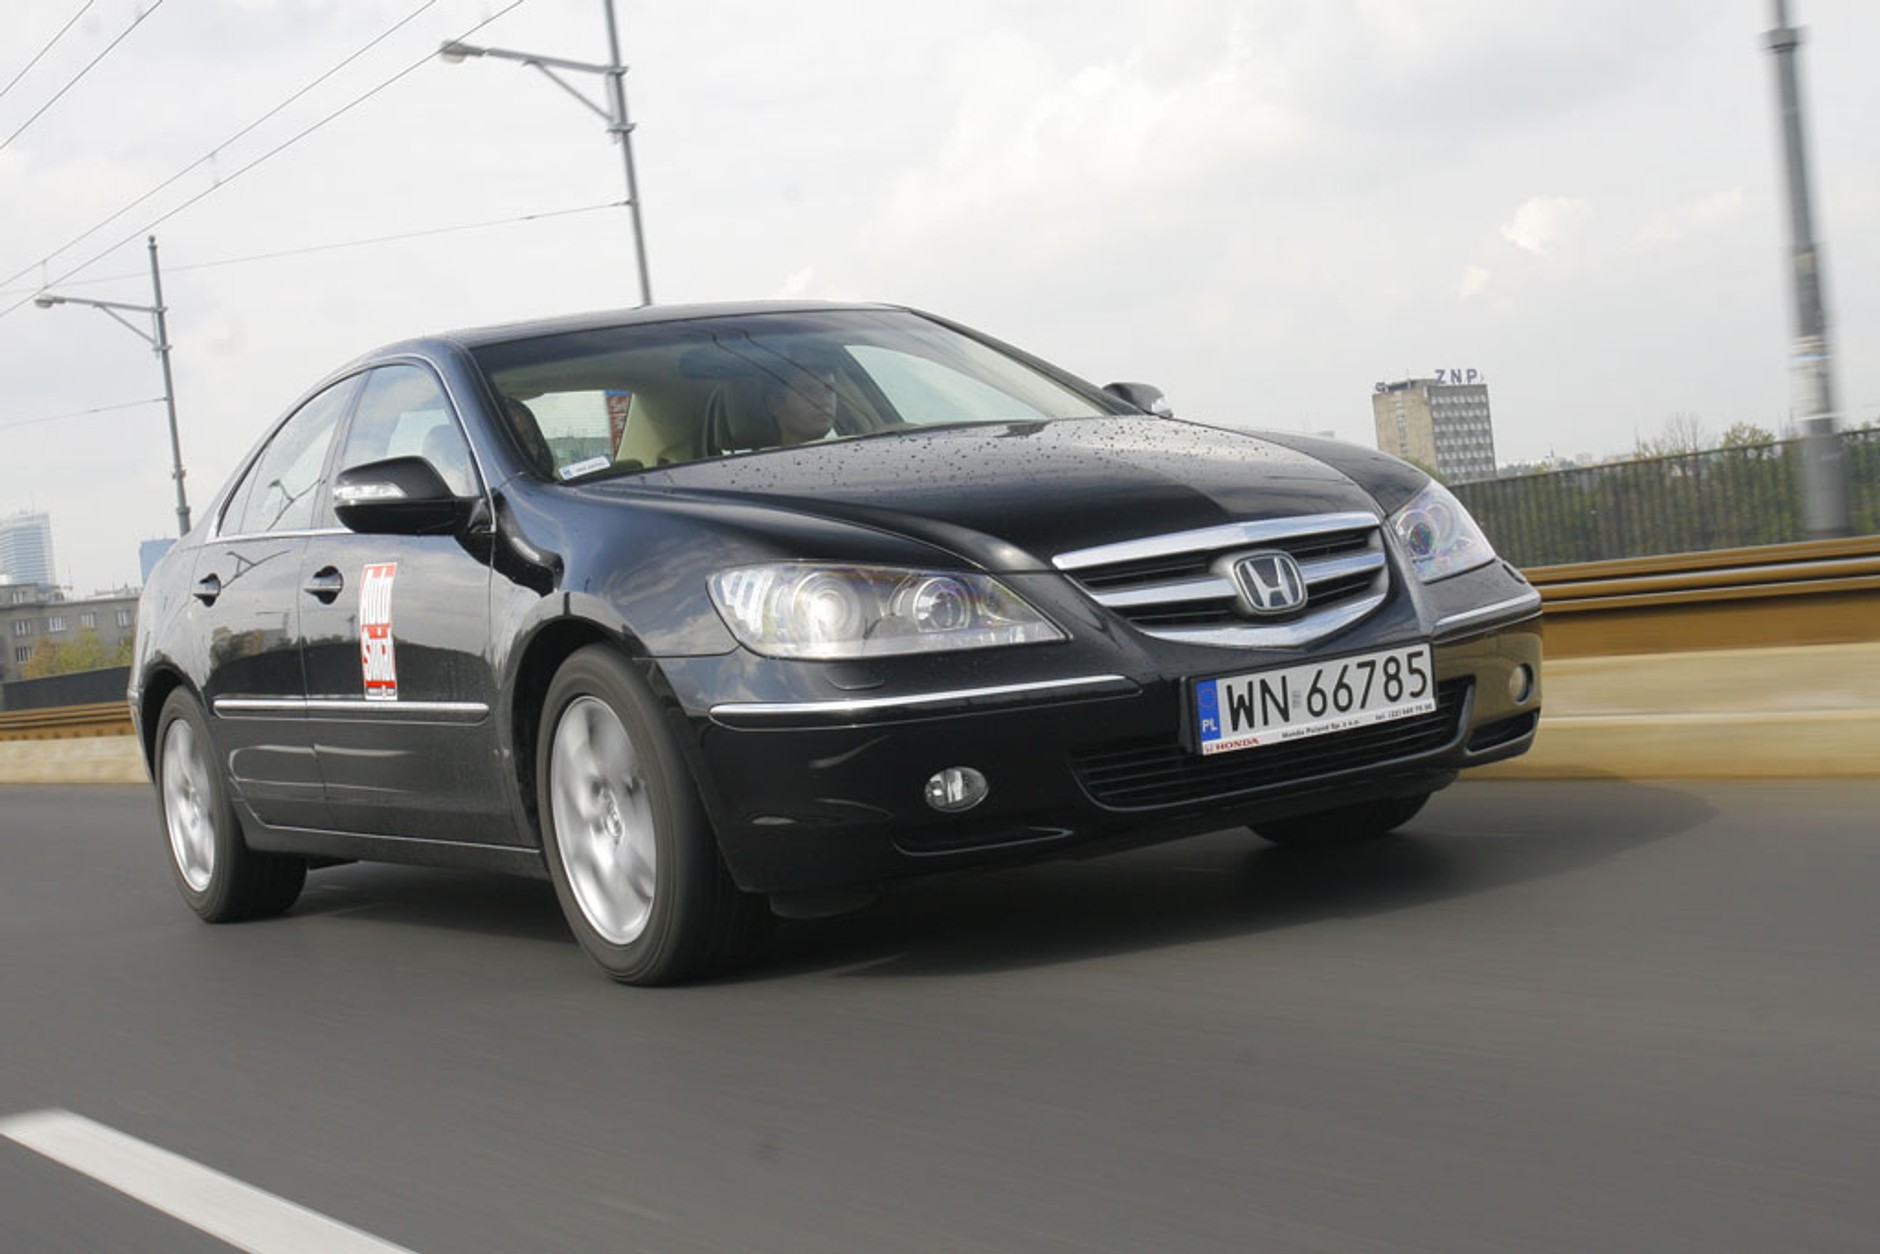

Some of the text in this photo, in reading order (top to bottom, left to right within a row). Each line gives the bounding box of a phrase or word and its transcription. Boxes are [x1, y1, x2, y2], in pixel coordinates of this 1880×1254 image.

[1435, 368, 1478, 385] ZNP
[1226, 650, 1427, 732] WN 66785
[1202, 718, 1218, 732] PL
[1215, 738, 1259, 750] HONDA
